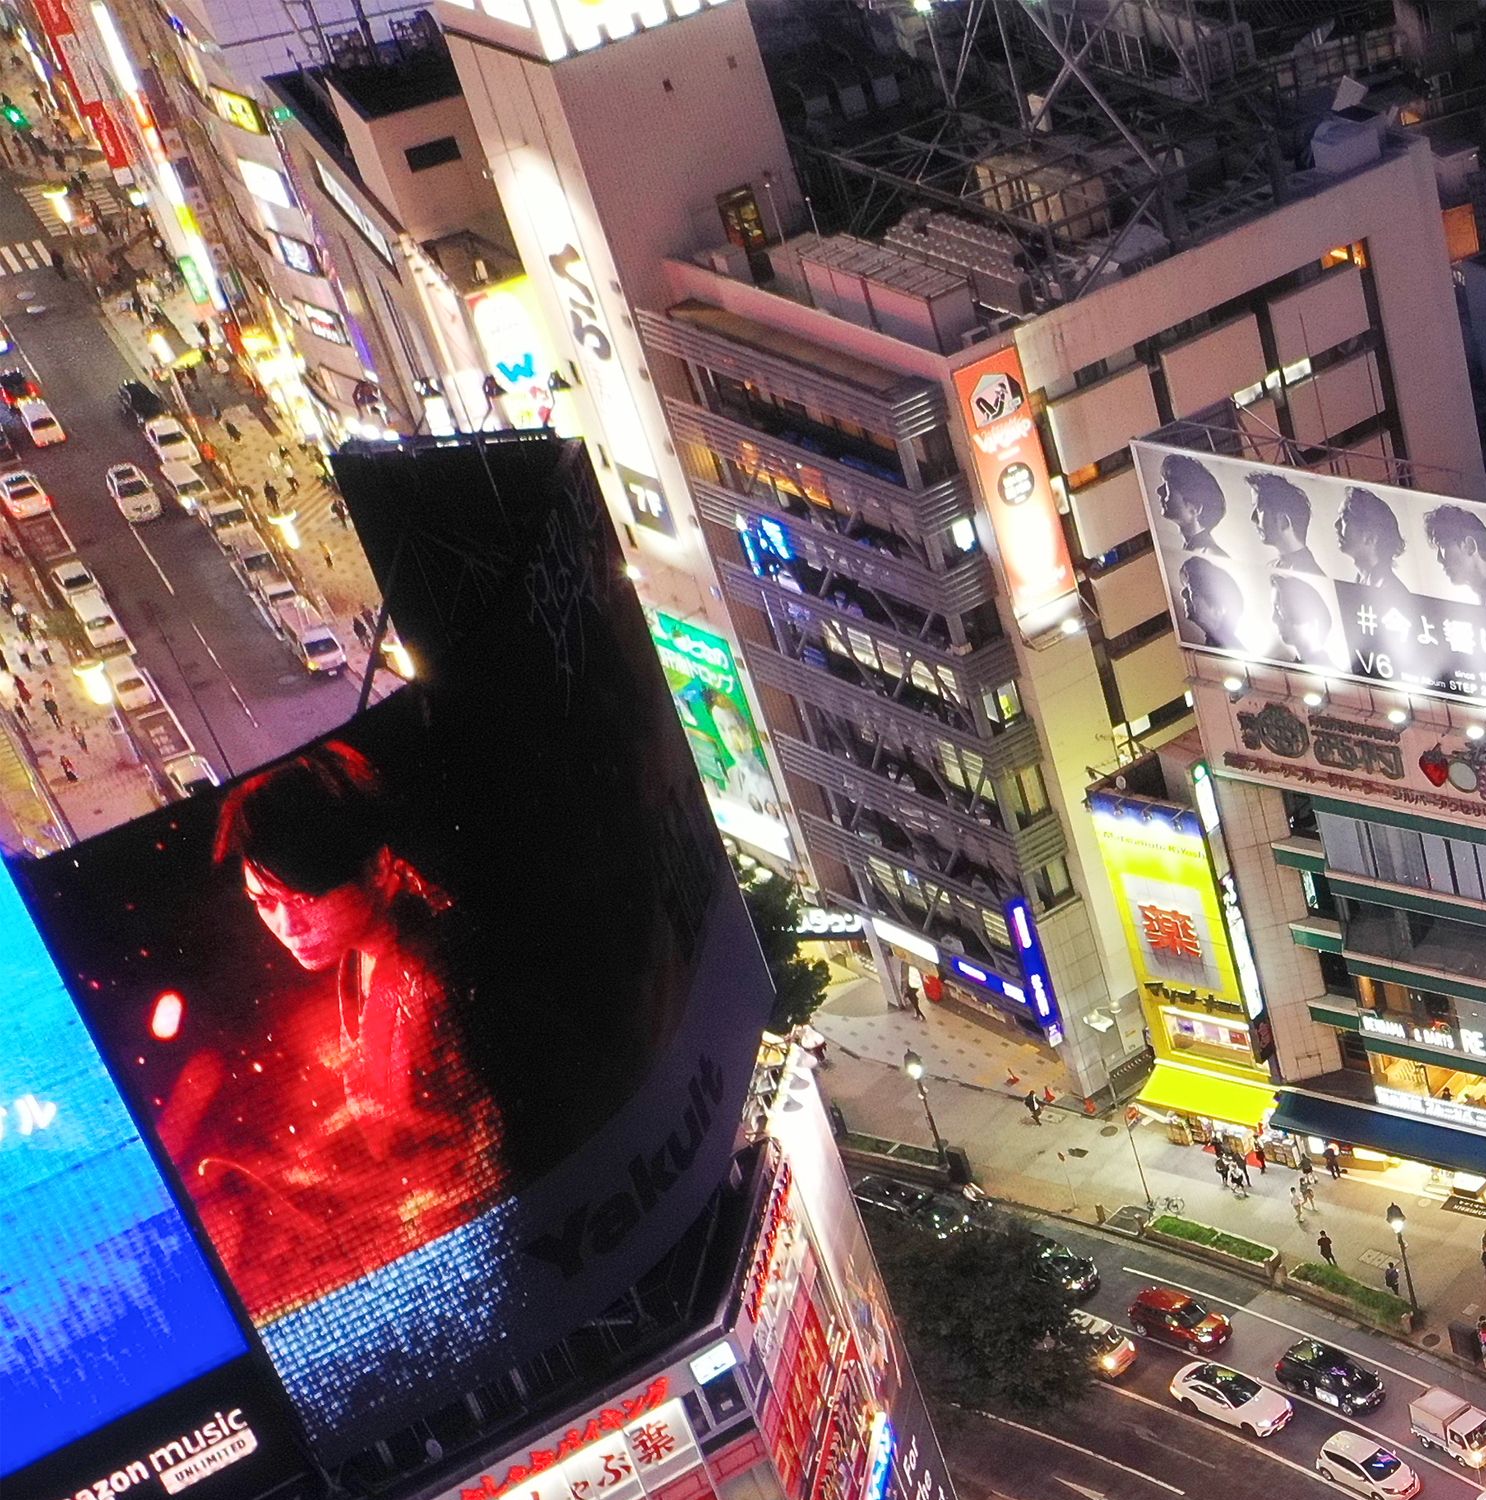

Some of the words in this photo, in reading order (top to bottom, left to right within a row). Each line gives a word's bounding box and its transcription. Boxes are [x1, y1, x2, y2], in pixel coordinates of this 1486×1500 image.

[629, 483, 664, 516] 7F
[1356, 649, 1393, 680] V6
[1449, 681, 1478, 694] STEP
[1137, 900, 1203, 957] 薬
[1422, 1030, 1455, 1050] DARTS
[148, 1404, 249, 1474] music
[172, 1436, 249, 1485] UNLIMITED
[902, 1436, 919, 1487] For
